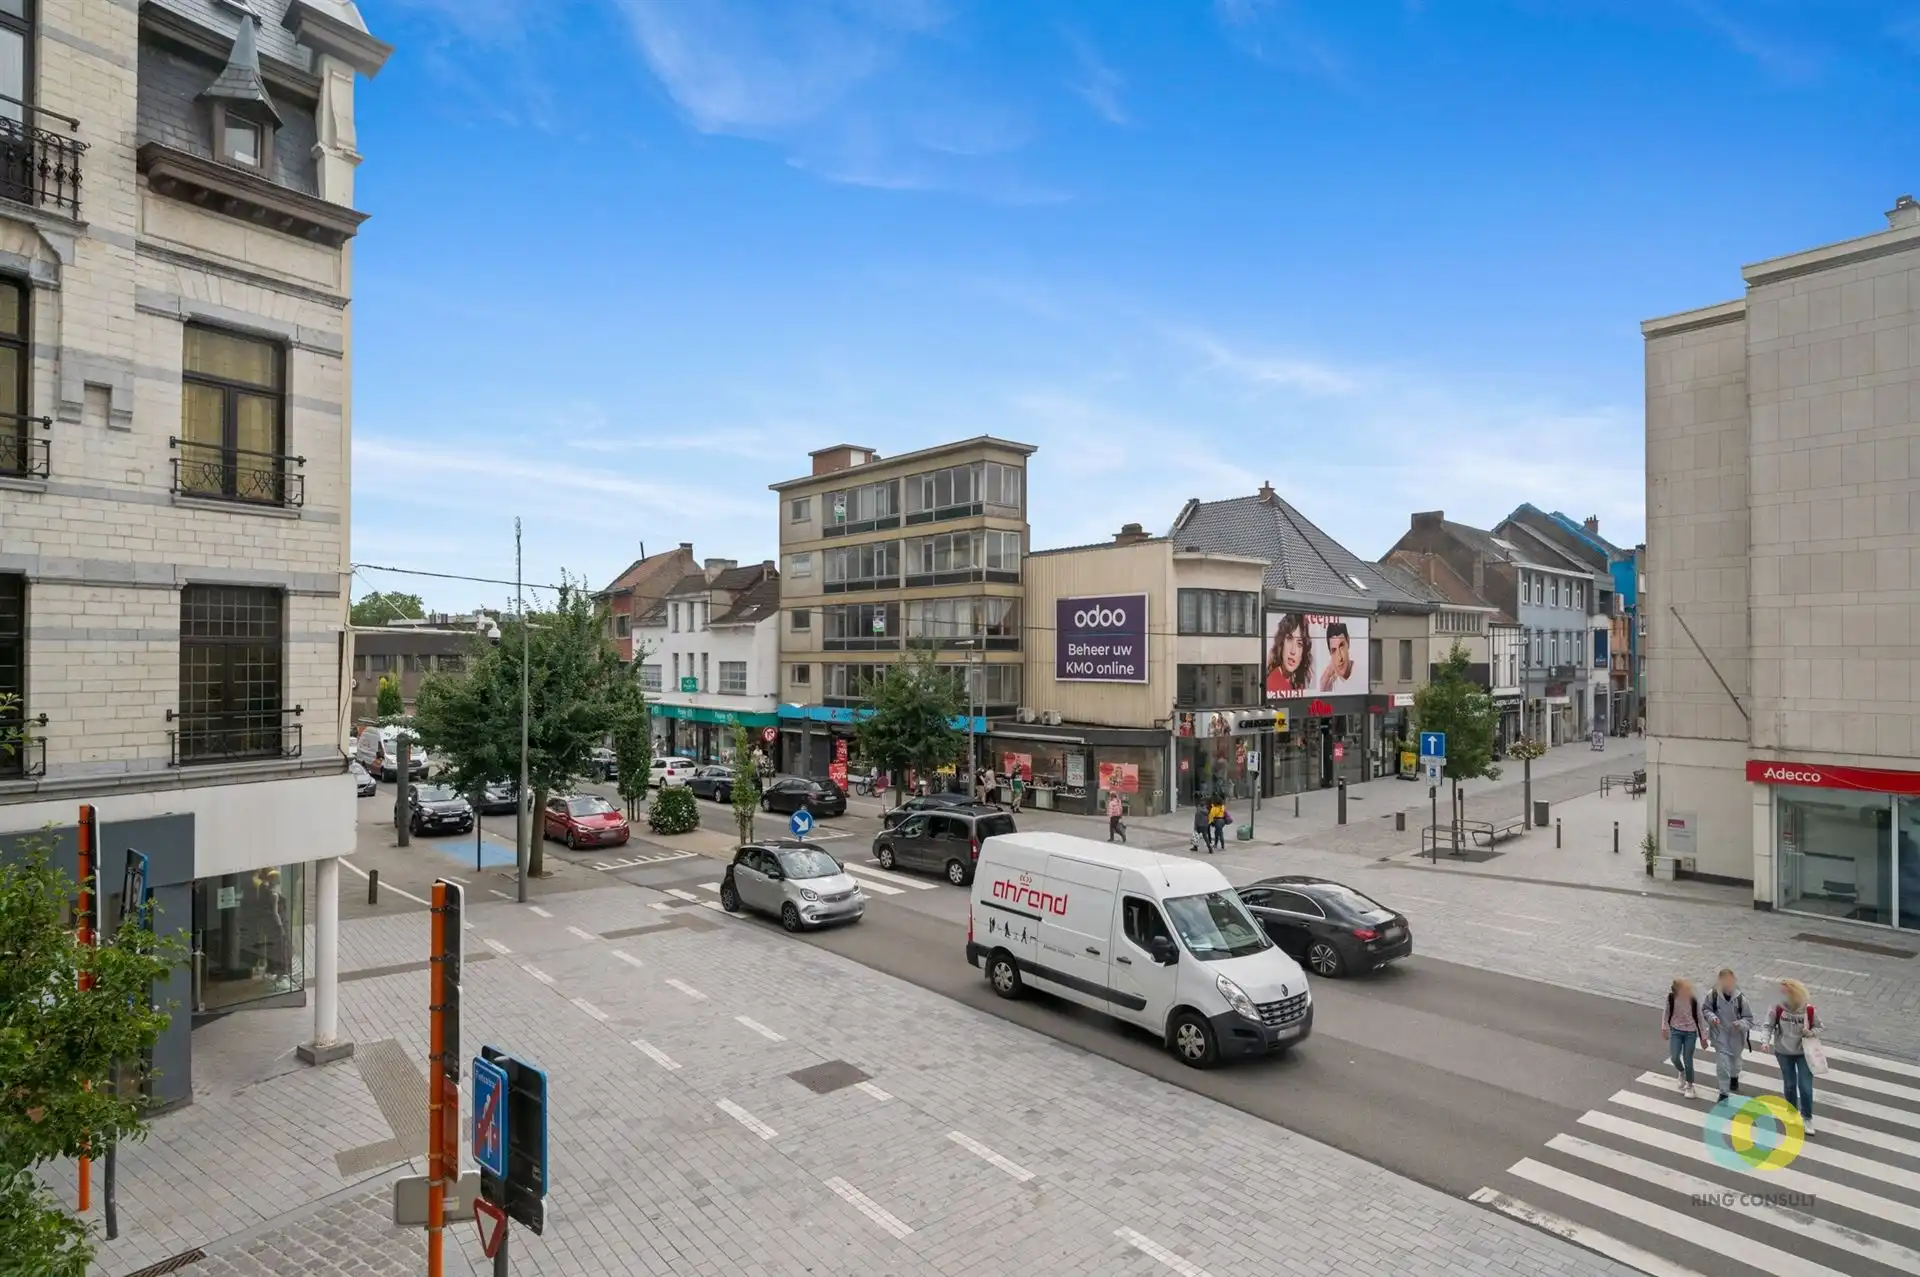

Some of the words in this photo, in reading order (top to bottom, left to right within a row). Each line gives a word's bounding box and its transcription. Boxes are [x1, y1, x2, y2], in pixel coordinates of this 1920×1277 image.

[1074, 604, 1126, 628] odoo
[1068, 643, 1110, 656] Beheer
[1113, 645, 1132, 656] uw
[1066, 661, 1094, 675] KMO
[1096, 661, 1135, 675] online
[1763, 767, 1821, 783] Adecco
[993, 879, 1068, 916] ahrend
